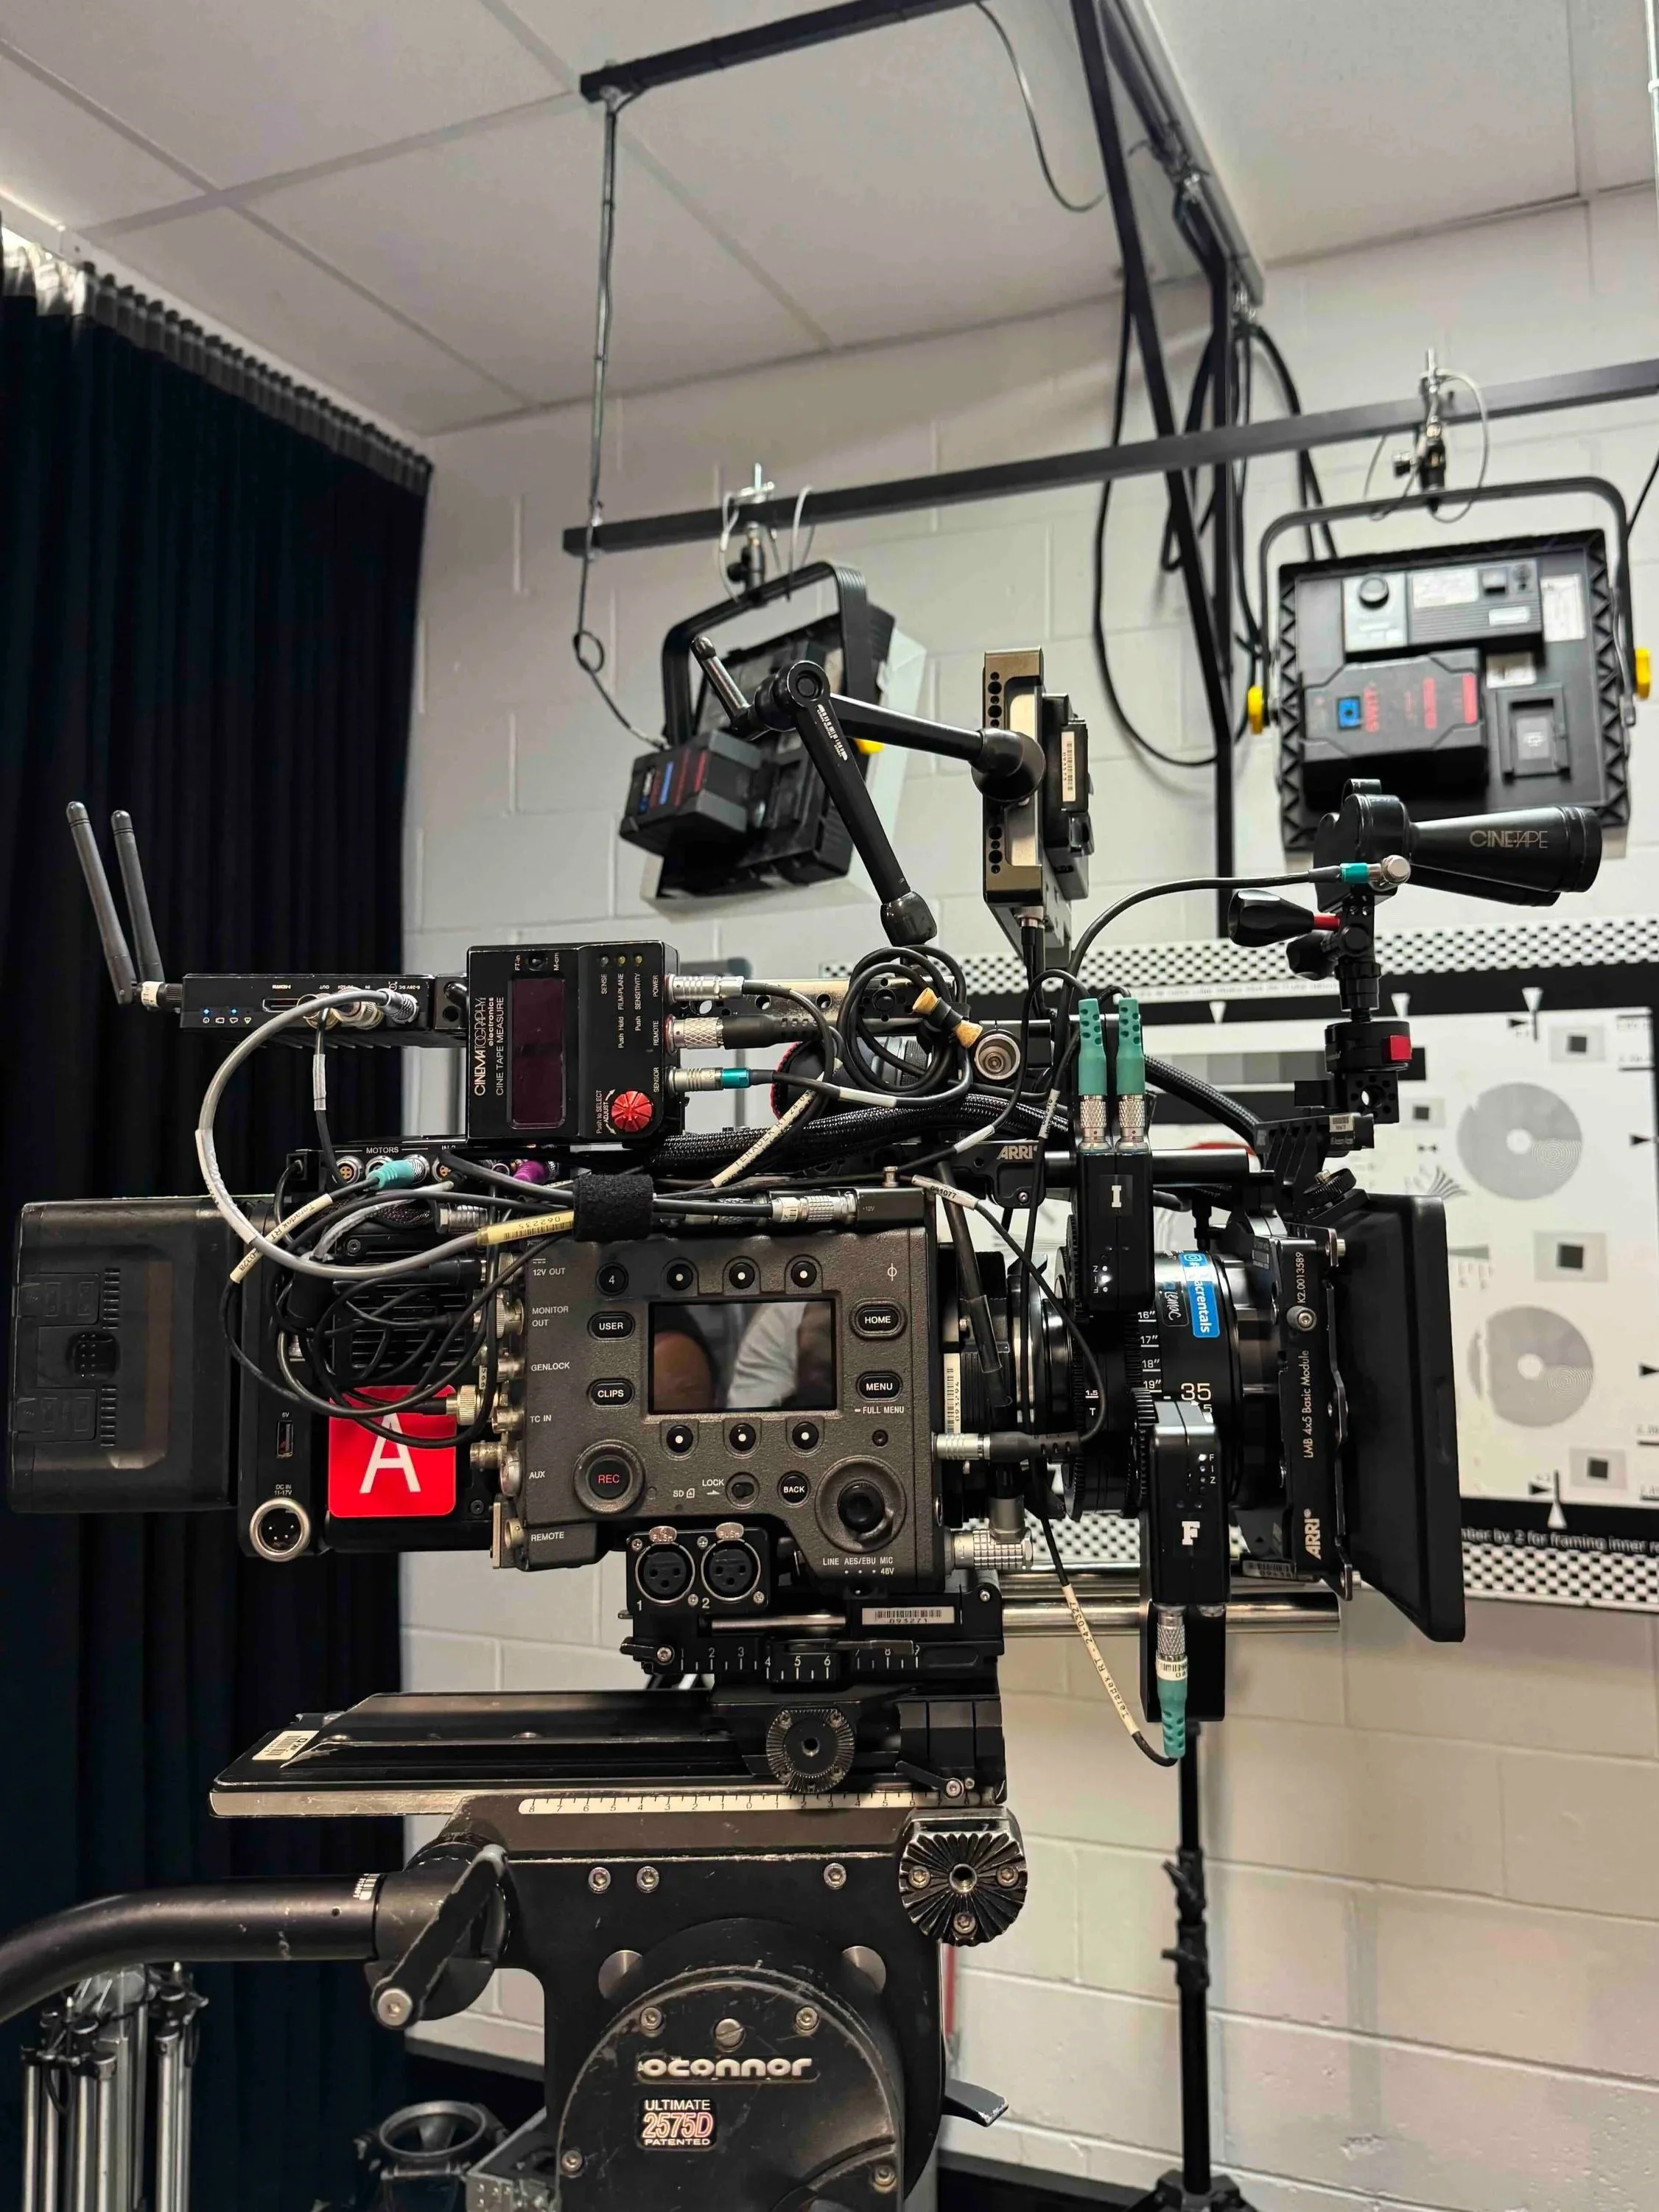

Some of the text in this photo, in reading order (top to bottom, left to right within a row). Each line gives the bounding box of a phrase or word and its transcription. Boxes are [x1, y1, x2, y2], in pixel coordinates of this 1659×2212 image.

[496, 997, 504, 1096] CINE TAPE MEASURE
[365, 1146, 399, 1154] MOTORS
[996, 1145, 1034, 1160] ARRI
[271, 1229, 283, 1240] RT
[533, 1267, 566, 1277] 12V OUT
[608, 1276, 615, 1285] 4
[1189, 1261, 1213, 1333] acrentals
[532, 1305, 569, 1316] MONITOR
[532, 1319, 549, 1327] OUT
[598, 1321, 623, 1330] USER
[864, 1316, 891, 1324] HOME
[530, 1361, 570, 1372] GENLOCK
[866, 1382, 893, 1391] MENU
[1180, 1382, 1212, 1401] 35
[597, 1389, 624, 1398] CLIPS
[1298, 1349, 1314, 1458] LMB 4x5 Basic Module
[862, 1405, 905, 1414] FULL MENU
[1089, 1408, 1096, 1416] T
[530, 1414, 552, 1423] TC IN
[359, 1411, 421, 1494] A
[1210, 1453, 1214, 1461] F
[529, 1470, 545, 1479] AUX
[598, 1475, 620, 1484] REC
[673, 1489, 684, 1498] SD
[783, 1485, 804, 1495] BACK
[530, 1531, 564, 1542] REMOTE
[1182, 1520, 1201, 1545] F
[1303, 1517, 1322, 1560] ARRI
[1515, 1529, 1525, 1542] 2
[1527, 1530, 1548, 1545] for
[1550, 1532, 1606, 1551] framing
[1609, 1536, 1647, 1551] inner
[822, 1556, 894, 1566] LINE AES/EBU MIC
[880, 1567, 894, 1575] 48V
[701, 1598, 710, 1609] 2
[709, 1647, 715, 1657] 2
[738, 1647, 744, 1657] 3
[765, 1656, 771, 1666] 4
[794, 1656, 801, 1666] 5
[824, 1656, 831, 1666] 6
[1094, 1657, 1106, 1672] RT
[1105, 1676, 1129, 1719] Teradek
[645, 2099, 710, 2111] ULTIMATE
[642, 2113, 714, 2138] 2575D
